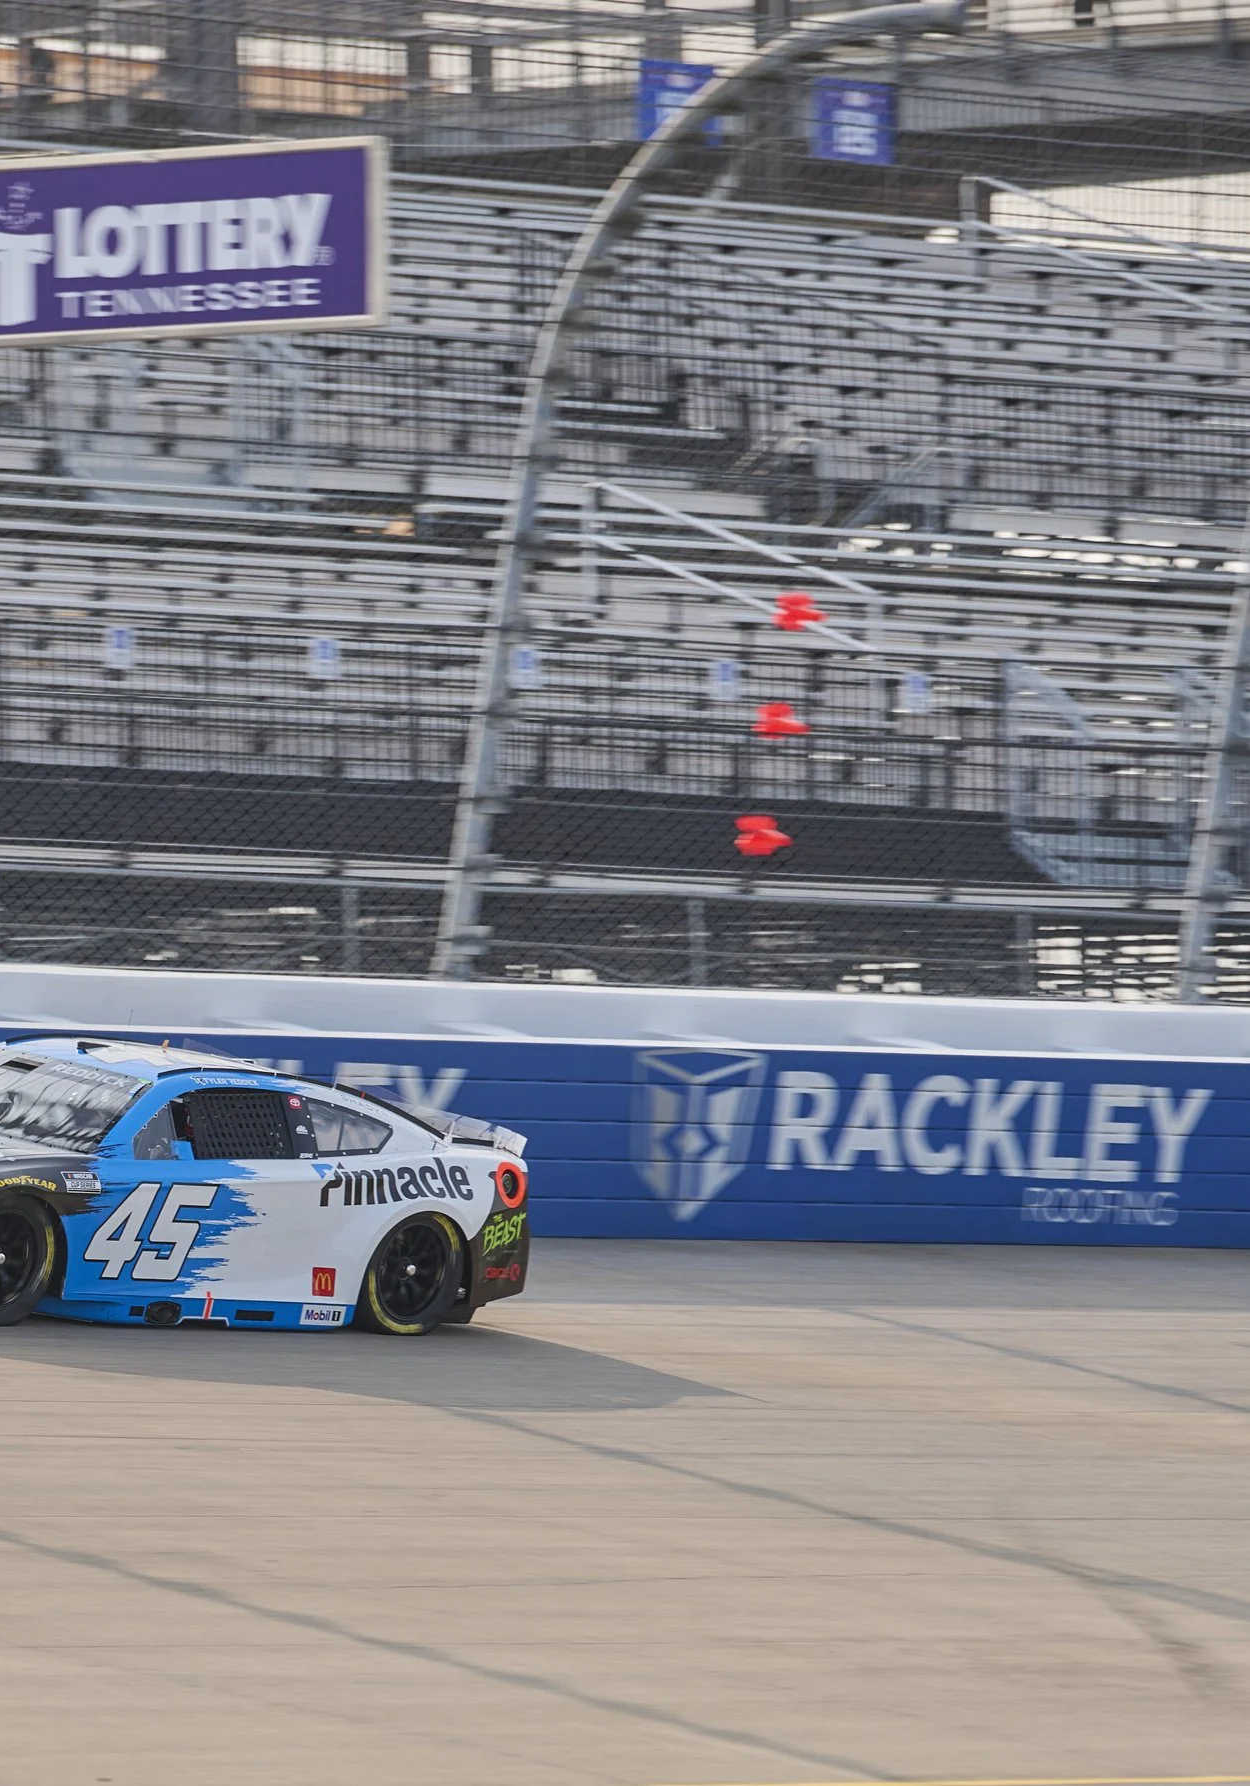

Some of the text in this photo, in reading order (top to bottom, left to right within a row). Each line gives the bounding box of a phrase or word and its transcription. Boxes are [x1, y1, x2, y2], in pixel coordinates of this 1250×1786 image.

[54, 193, 332, 278] LOTTERY
[55, 278, 321, 318] TENNESSEE
[51, 1063, 126, 1087] REDDICK
[765, 1070, 1215, 1183] RACKLEY
[310, 1157, 474, 1207] Pinnacle
[1020, 1186, 1180, 1226] ROOFING
[83, 1181, 220, 1281] 45
[482, 1212, 527, 1256] BEAST
[304, 1309, 331, 1321] Mobil
